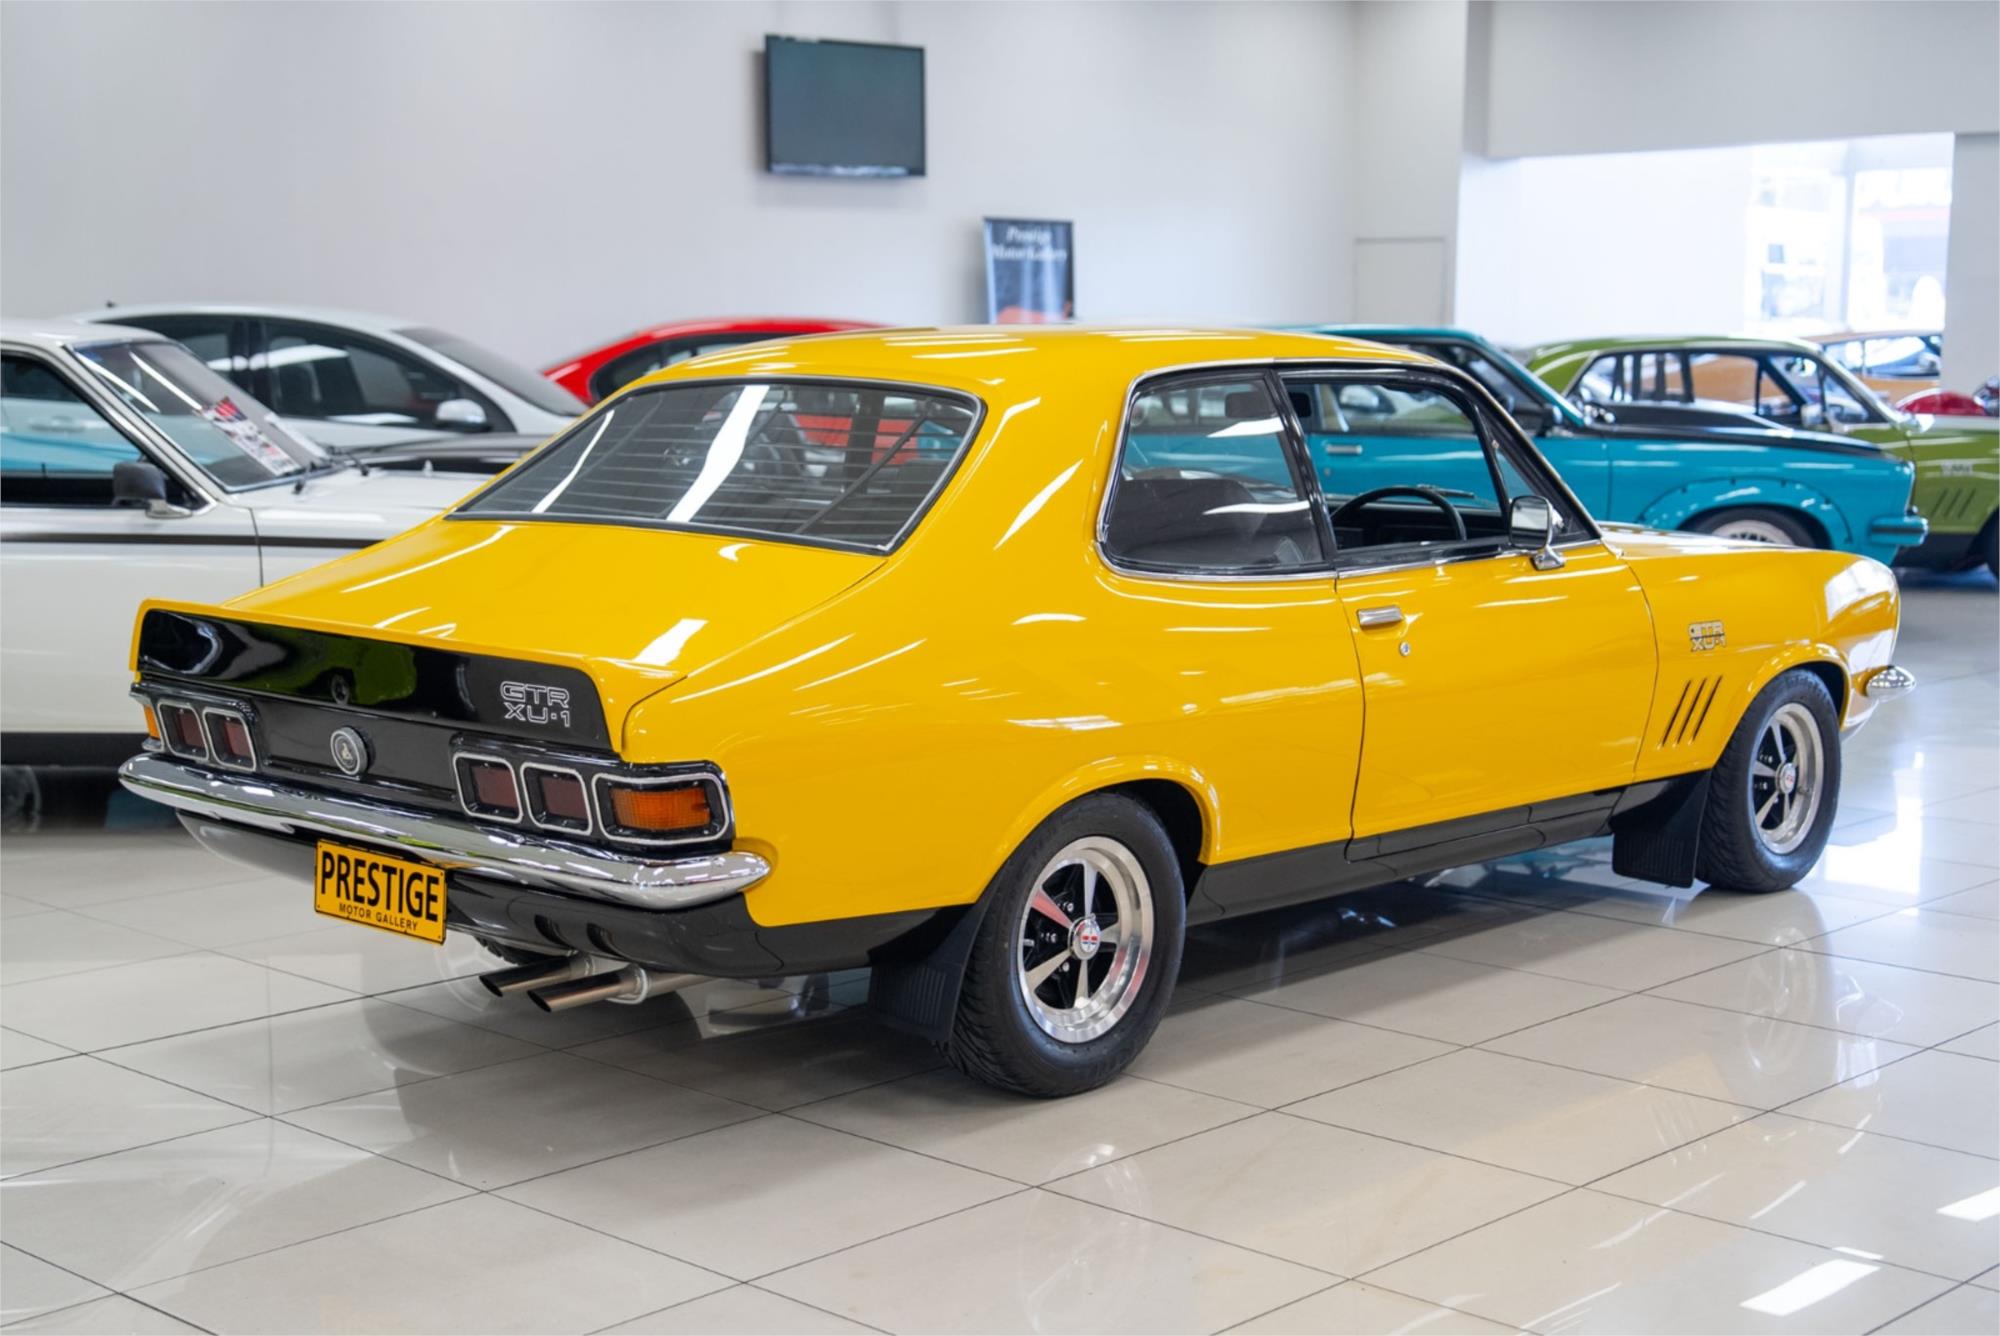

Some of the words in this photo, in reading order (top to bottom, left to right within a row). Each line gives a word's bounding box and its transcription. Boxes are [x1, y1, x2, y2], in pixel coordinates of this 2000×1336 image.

[501, 681, 569, 708] GTR
[321, 850, 440, 922] PRESTIGE
[339, 903, 371, 919] MOTOR
[376, 912, 418, 931] GALLERY
